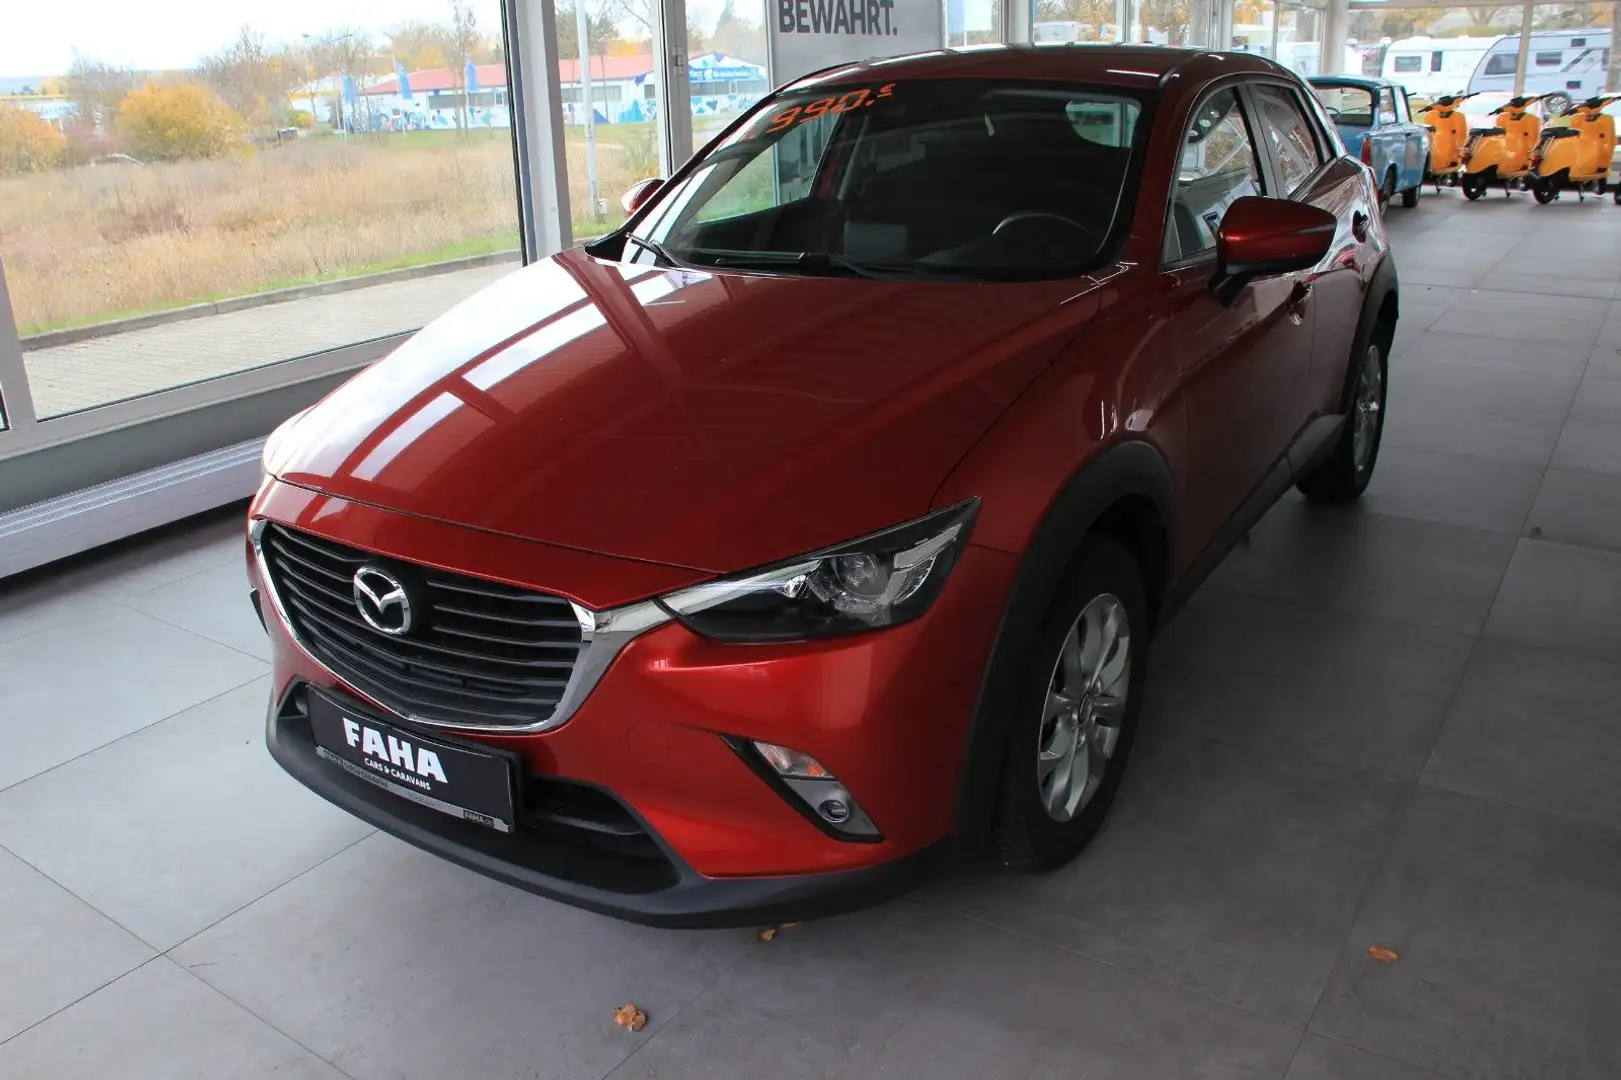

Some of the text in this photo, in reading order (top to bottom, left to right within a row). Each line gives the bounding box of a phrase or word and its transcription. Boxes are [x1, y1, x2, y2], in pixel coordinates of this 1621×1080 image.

[779, 0, 898, 36] BEWAHRT.
[343, 717, 448, 784] FAHA
[364, 757, 383, 772] CARS
[390, 768, 431, 791] CARAVANS
